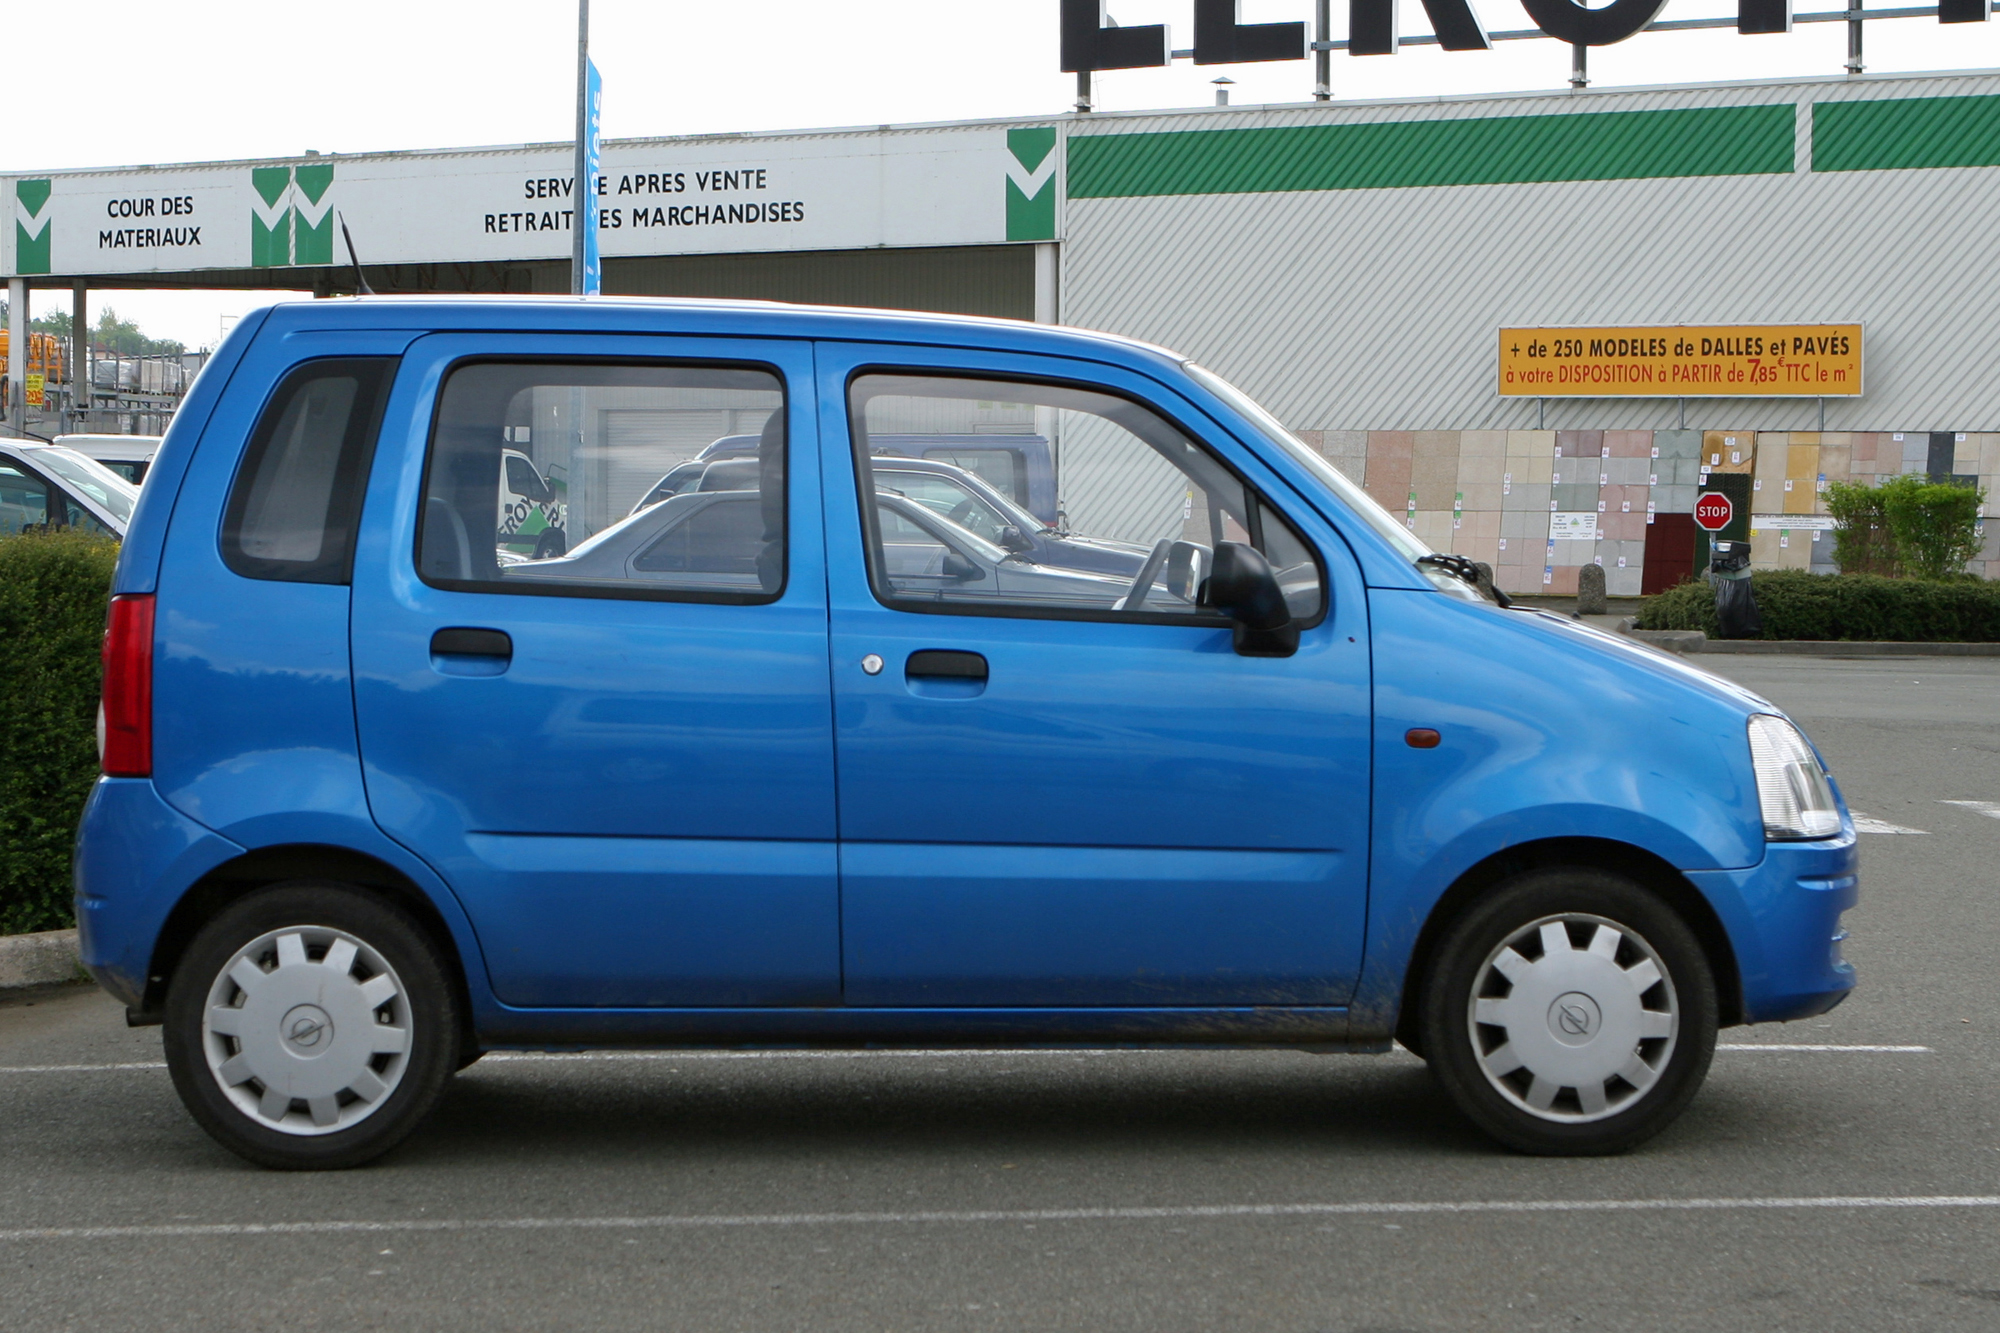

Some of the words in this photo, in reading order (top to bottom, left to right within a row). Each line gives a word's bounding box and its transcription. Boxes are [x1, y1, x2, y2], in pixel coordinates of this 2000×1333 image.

[524, 177, 608, 200] SERVE
[617, 173, 686, 195] APRES
[695, 169, 767, 192] VENTE
[107, 198, 155, 218] COUR
[161, 196, 194, 216] DES
[484, 210, 574, 233] RETRAIT
[597, 208, 623, 230] ES
[632, 201, 805, 228] MARCHANDISES
[99, 227, 201, 249] MATERIAUX
[1528, 339, 1547, 358] de
[1553, 339, 1583, 358] 250
[1589, 338, 1667, 357] MODELES
[1674, 337, 1694, 357] de
[1701, 337, 1763, 356] DALLES
[1770, 339, 1786, 356] et
[1793, 331, 1849, 356] PAVÉS
[1506, 365, 1514, 383] à
[1519, 367, 1554, 383] votre
[1559, 364, 1652, 383] DISPOSITION
[1658, 364, 1667, 383] à
[1672, 364, 1722, 383] PARTIR
[1727, 362, 1744, 382] de
[1786, 363, 1810, 382] TTC
[1816, 361, 1828, 382] le
[1698, 506, 1728, 517] STOP
